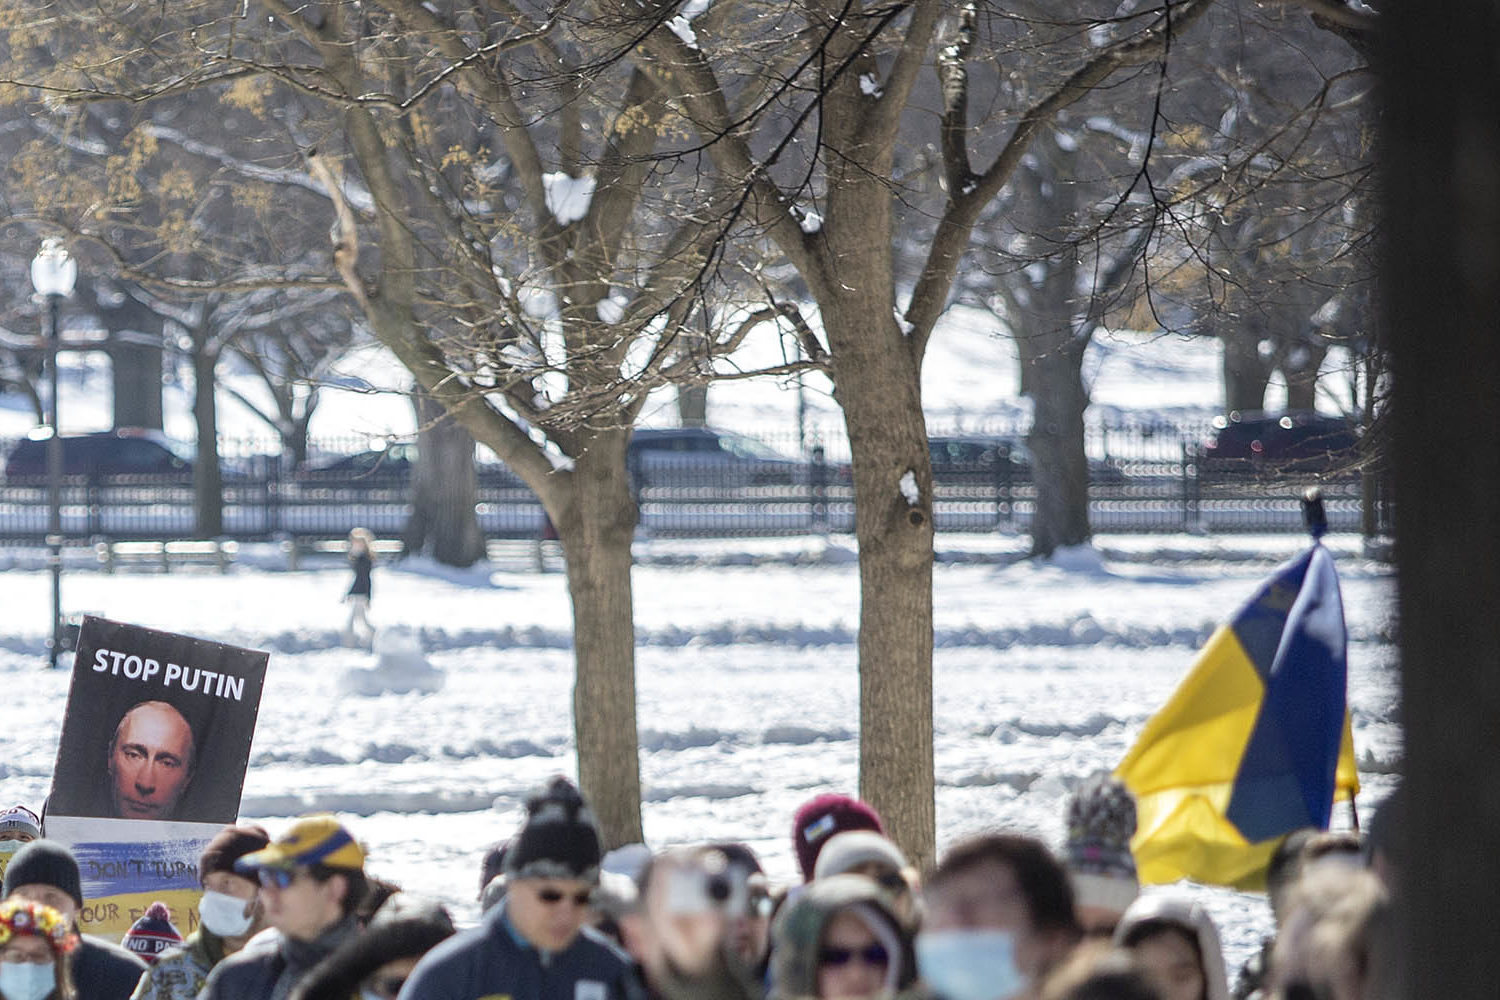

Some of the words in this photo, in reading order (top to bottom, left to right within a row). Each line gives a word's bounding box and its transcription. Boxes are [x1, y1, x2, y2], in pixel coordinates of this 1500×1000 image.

[92, 648, 160, 682] STOP
[163, 663, 245, 701] PUTIN
[87, 859, 145, 880] DON'T
[151, 860, 198, 881] TURN
[128, 906, 179, 926] FE
